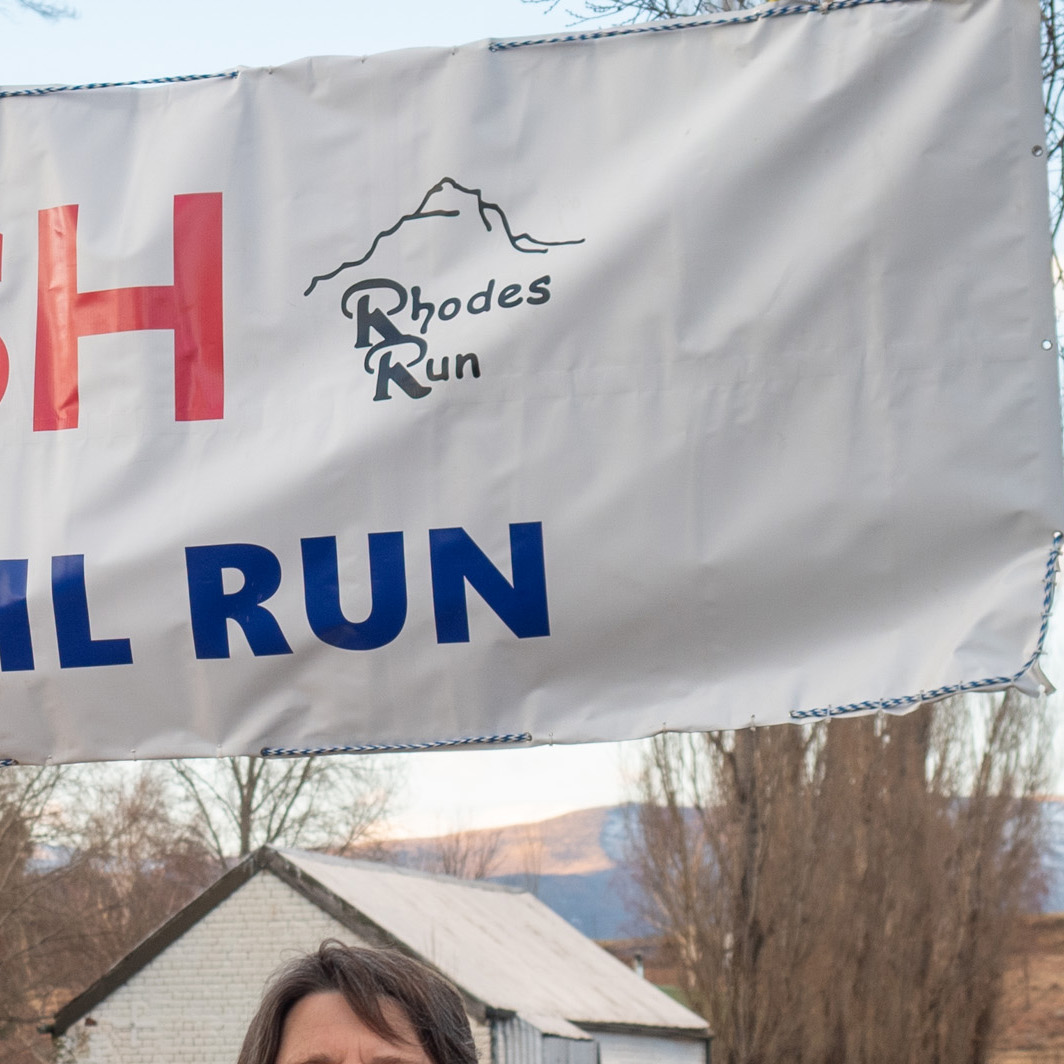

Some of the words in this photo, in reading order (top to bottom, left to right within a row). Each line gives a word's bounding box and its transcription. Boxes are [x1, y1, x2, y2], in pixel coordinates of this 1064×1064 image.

[341, 275, 552, 348] Rhodes
[364, 334, 481, 401] Run
[184, 521, 551, 660] RUN
